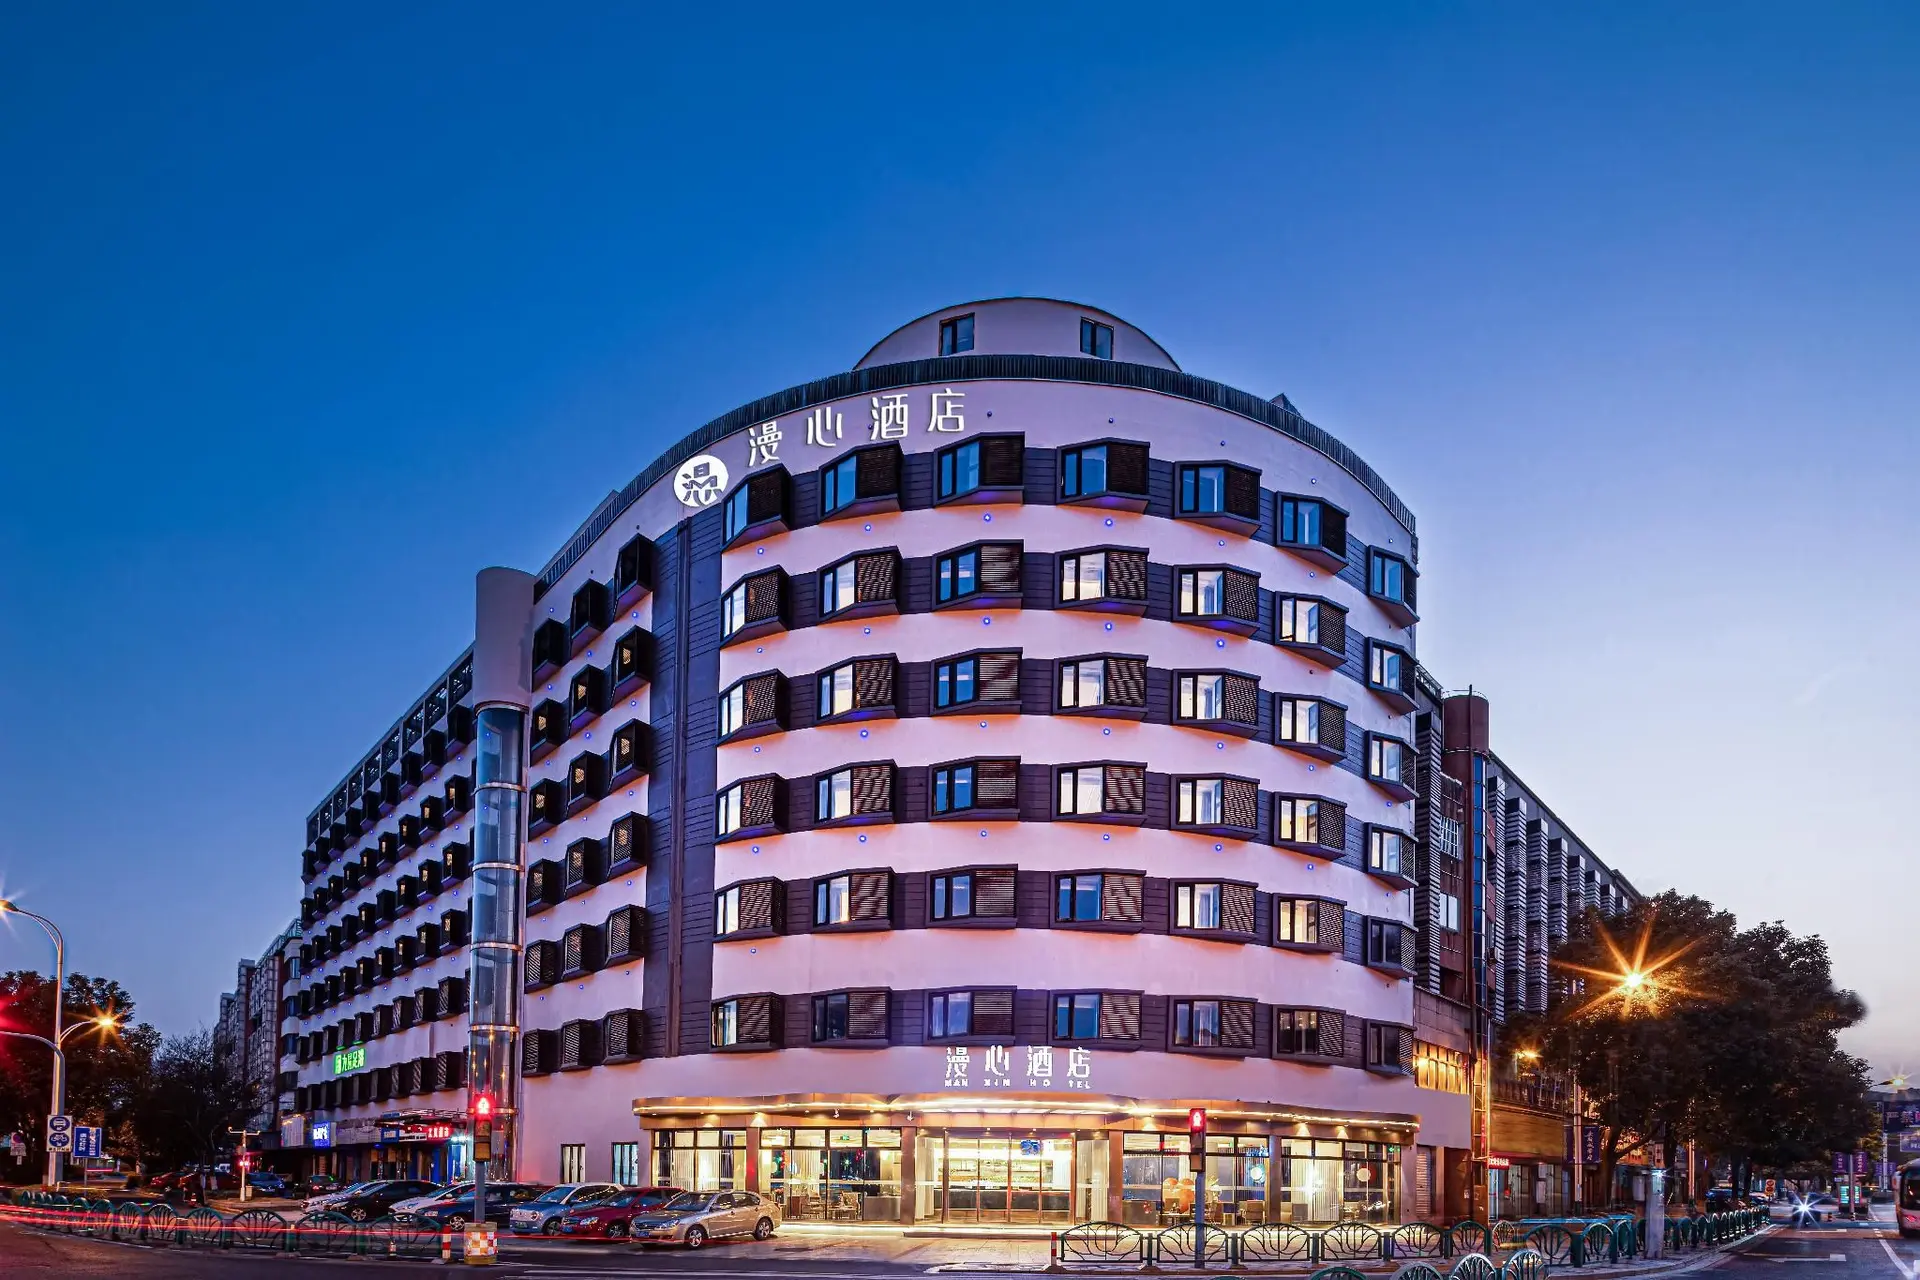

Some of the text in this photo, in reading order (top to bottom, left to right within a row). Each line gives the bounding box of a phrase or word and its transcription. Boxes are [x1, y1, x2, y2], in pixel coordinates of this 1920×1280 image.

[747, 387, 966, 467] 漫心酒店
[945, 1044, 1091, 1078] 漫心酒店
